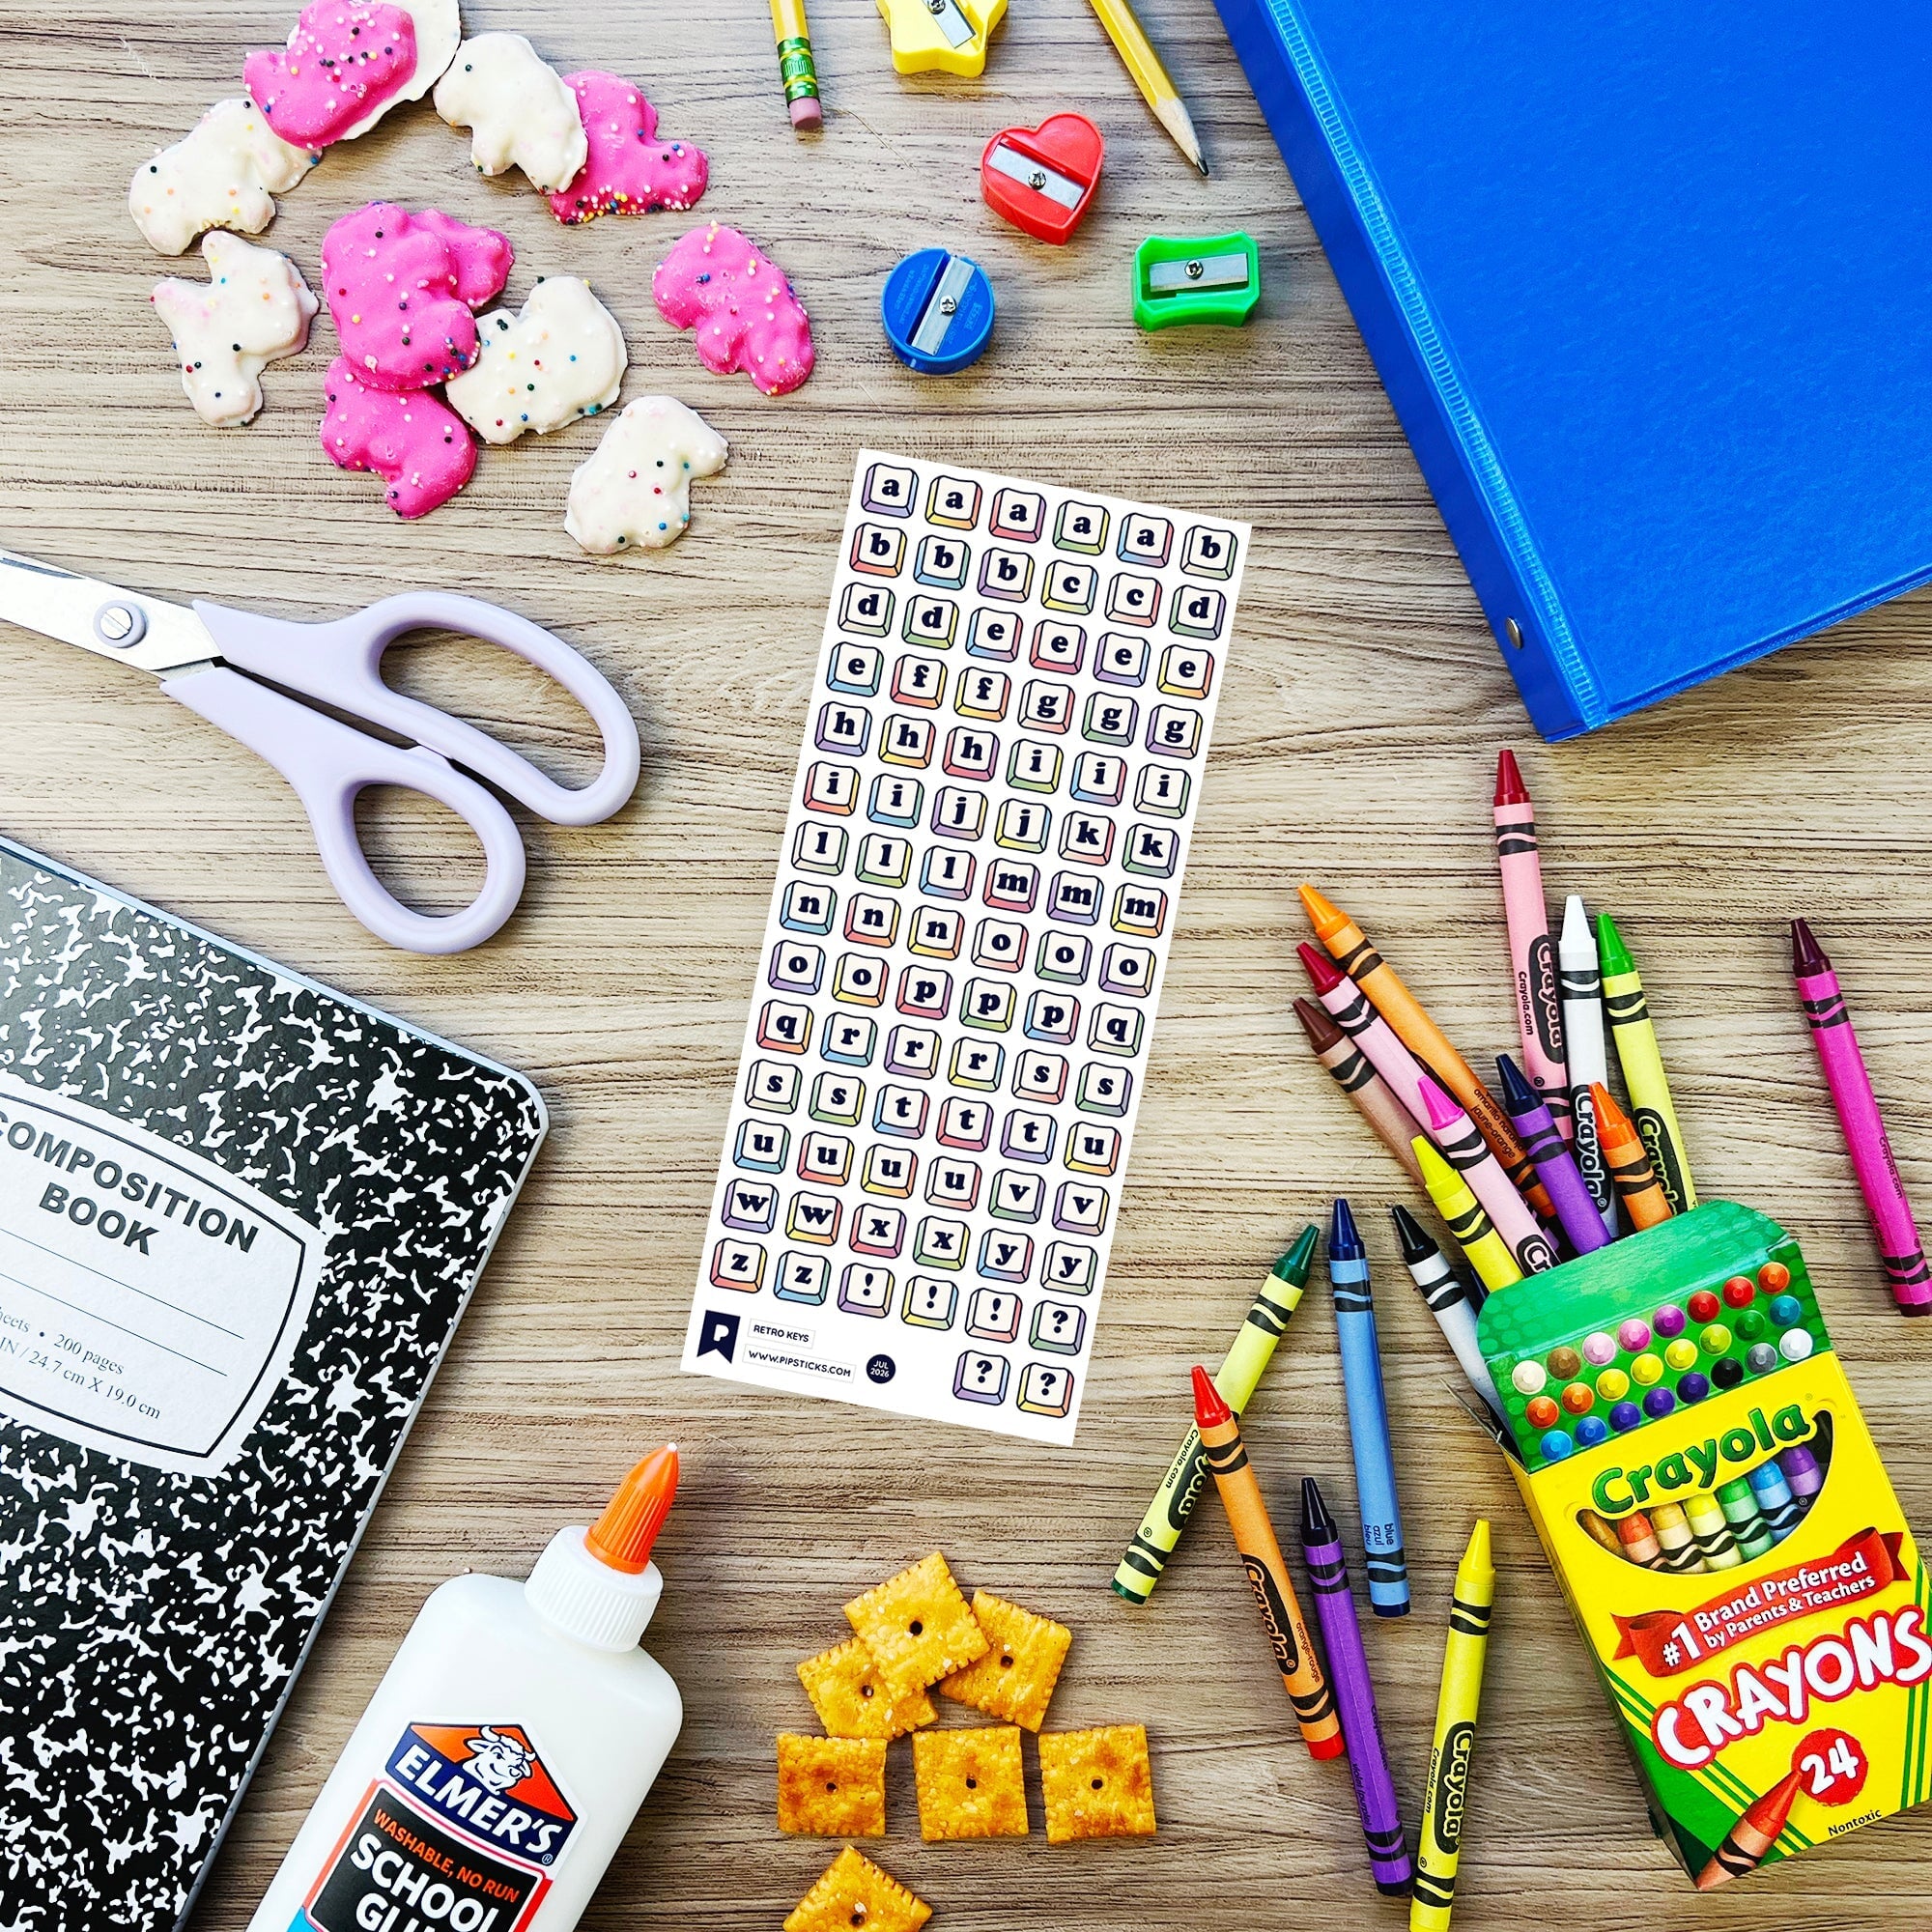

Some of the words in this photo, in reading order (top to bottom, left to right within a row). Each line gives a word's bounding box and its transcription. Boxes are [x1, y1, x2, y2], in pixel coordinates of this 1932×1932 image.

[881, 478, 900, 497] a
[945, 491, 964, 510] a
[1009, 503, 1028, 523] a
[1072, 516, 1092, 535] a
[1136, 528, 1155, 548] a
[1200, 535, 1221, 559] b
[869, 532, 891, 556] b
[933, 545, 954, 569] b
[997, 557, 1018, 582] b
[1063, 576, 1081, 594] c
[1126, 588, 1145, 607] c
[1188, 596, 1210, 619] d
[857, 593, 880, 616] d
[921, 606, 944, 629] d
[986, 623, 1006, 641] e
[1050, 636, 1068, 653] e
[1115, 648, 1133, 666] e
[1178, 660, 1196, 678] e
[847, 658, 866, 675] e
[912, 664, 930, 688] f
[976, 676, 994, 700] f
[1037, 695, 1059, 719] g
[1100, 707, 1122, 731] g
[1164, 720, 1187, 744] g
[833, 711, 855, 736] h
[895, 724, 919, 749] h
[960, 736, 983, 761] h
[1029, 749, 1042, 773] i
[1093, 761, 1107, 785] i
[1156, 774, 1171, 798] i
[826, 771, 839, 795] i
[890, 783, 903, 808] i
[952, 796, 967, 825] j
[1015, 809, 1031, 838] j
[1075, 820, 1100, 846] k
[1139, 833, 1164, 859] k
[814, 831, 829, 855] l
[878, 843, 893, 867] l
[942, 856, 956, 880] l
[996, 872, 1029, 894] m
[1060, 885, 1093, 906] m
[1123, 897, 1156, 919] m
[798, 895, 820, 915] n
[862, 908, 884, 927] n
[925, 921, 948, 940] n
[991, 933, 1011, 952] o
[1055, 946, 1075, 964] o
[1119, 958, 1139, 977] o
[788, 955, 809, 974] o
[852, 968, 872, 986] o
[913, 980, 937, 1004] p
[977, 993, 1001, 1016] p
[1040, 1005, 1065, 1029] p
[1106, 1017, 1128, 1042] q
[1518, 971, 1534, 1036] Crayola.com
[776, 1015, 798, 1040] q
[840, 1028, 861, 1045] r
[904, 1040, 924, 1058] r
[968, 1053, 988, 1070] r
[1034, 1065, 1050, 1084] s
[1096, 1077, 1114, 1095] s
[766, 1075, 783, 1094] s
[830, 1087, 847, 1106] s
[895, 1096, 912, 1118] t
[959, 1109, 976, 1130] t
[1022, 1121, 1039, 1143] t
[1084, 1136, 1105, 1156] u
[1470, 1104, 1516, 1159] jaune-orange
[1473, 1088, 1500, 1122] amarillo
[753, 1134, 775, 1153] u
[816, 1146, 838, 1166] u
[880, 1158, 902, 1179] u
[945, 1171, 966, 1191] u
[1009, 1183, 1031, 1203] v
[1072, 1196, 1094, 1215] v
[1879, 1136, 1903, 1200] Crayola.com
[39, 1181, 159, 1256] BOOK
[736, 1192, 770, 1213] w
[800, 1205, 834, 1226] w
[867, 1218, 891, 1238] x
[931, 1231, 954, 1251] x
[994, 1243, 1019, 1266] y
[1058, 1256, 1083, 1279] y
[730, 1253, 750, 1272] z
[794, 1265, 813, 1285] z
[54, 1333, 82, 1355] 200
[82, 1350, 125, 1376] pages
[748, 1350, 851, 1378] WWW.PIPSTICKS.COM
[753, 1324, 784, 1338] RETRO
[785, 1330, 810, 1343] KEYS
[872, 1359, 889, 1370] JUL
[28, 1350, 63, 1373] 24.7
[63, 1369, 85, 1385] cm
[88, 1377, 104, 1392] X
[106, 1385, 137, 1407] 19.0
[138, 1403, 161, 1419] cm
[869, 1367, 890, 1378] 2026
[1165, 1429, 1199, 1489] Crayola.com
[1592, 1404, 1811, 1514] Crayola
[1373, 1525, 1385, 1546] azul
[1384, 1522, 1395, 1546] blue
[1692, 1586, 1762, 1633] Brand
[1761, 1551, 1868, 1601] Preferred
[1703, 1629, 1726, 1649] by
[1725, 1602, 1787, 1639] Parents
[1786, 1595, 1804, 1612] &
[1803, 1575, 1876, 1607] Teachers
[1295, 1622, 1321, 1683] orange-rouge
[1662, 1621, 1701, 1667] #1
[1656, 1610, 1932, 1764] CRAYONS
[394, 1744, 563, 1854] ELMER'S
[1443, 1729, 1474, 1837] Crayola
[1800, 1737, 1859, 1795] 24
[373, 1808, 455, 1879] WASHABLE,
[456, 1866, 482, 1889] NO
[483, 1879, 520, 1903] RUN
[1827, 1807, 1883, 1837] Nontoxic
